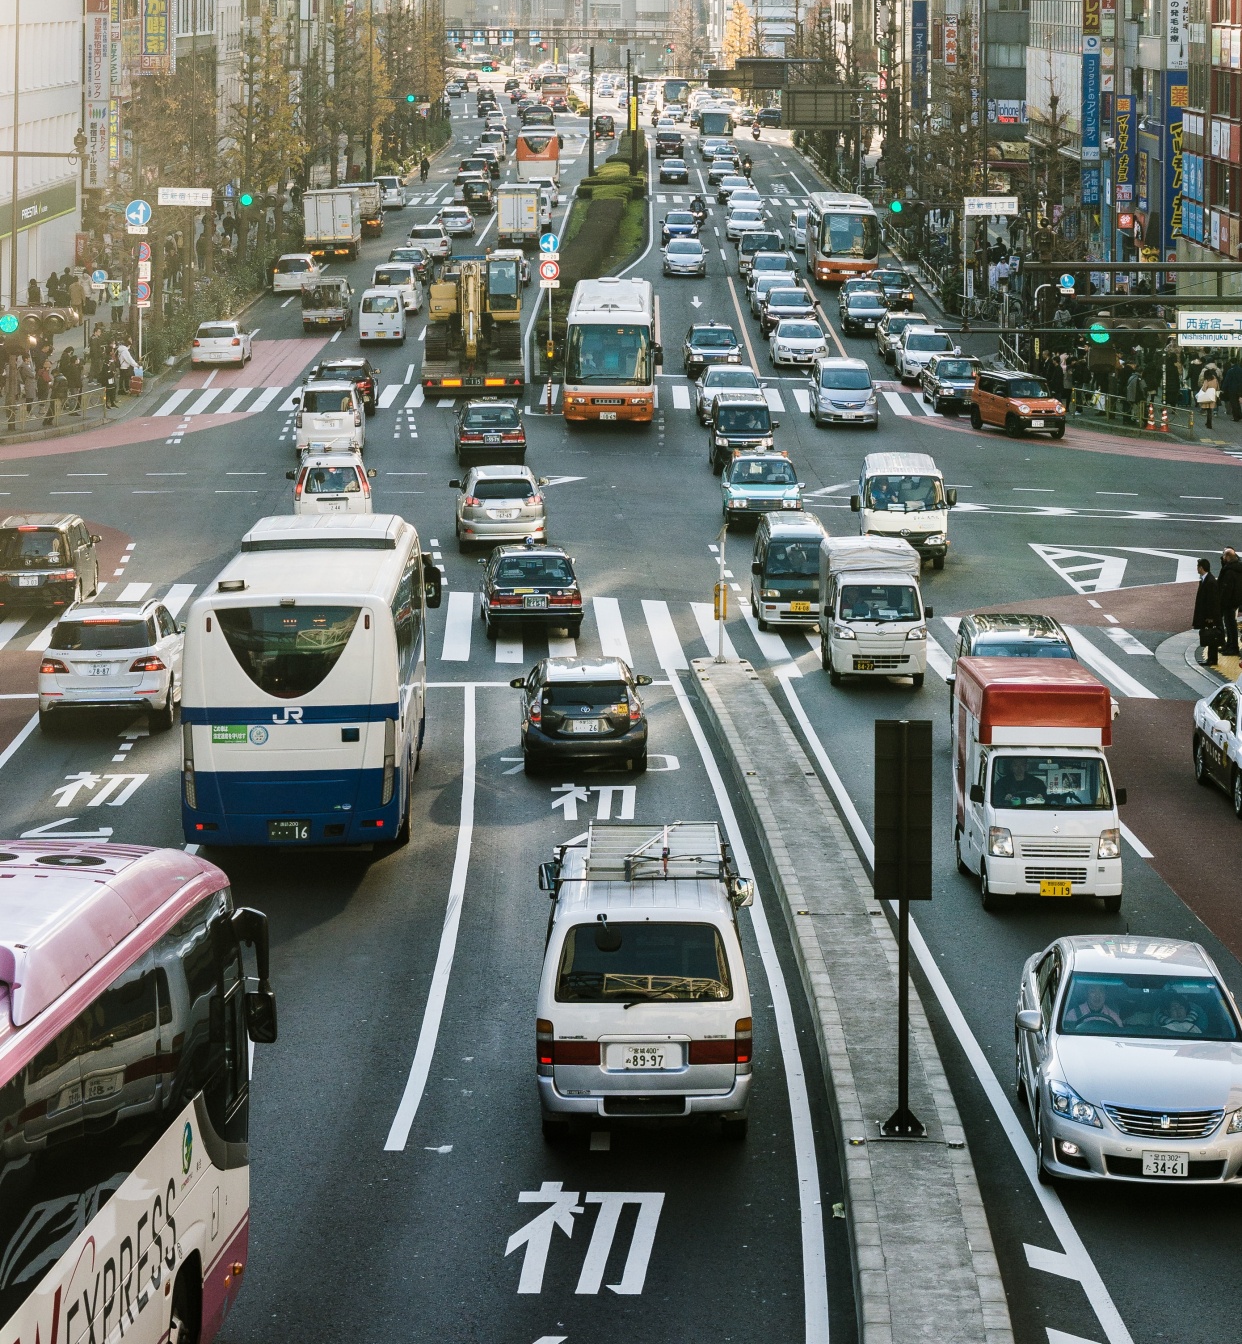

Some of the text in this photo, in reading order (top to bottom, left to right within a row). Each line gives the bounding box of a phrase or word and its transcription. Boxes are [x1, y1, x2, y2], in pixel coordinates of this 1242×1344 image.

[1181, 332, 1228, 342] Nishishinjuku
[92, 667, 110, 675] 78-87
[272, 706, 304, 724] JR
[589, 724, 598, 732] 26
[1201, 736, 1221, 766] POLICE
[550, 783, 637, 821] 初
[295, 826, 308, 839] 16
[632, 1055, 664, 1067] 89-97
[1152, 1161, 1184, 1175] 34-61
[504, 1181, 666, 1295] 初
